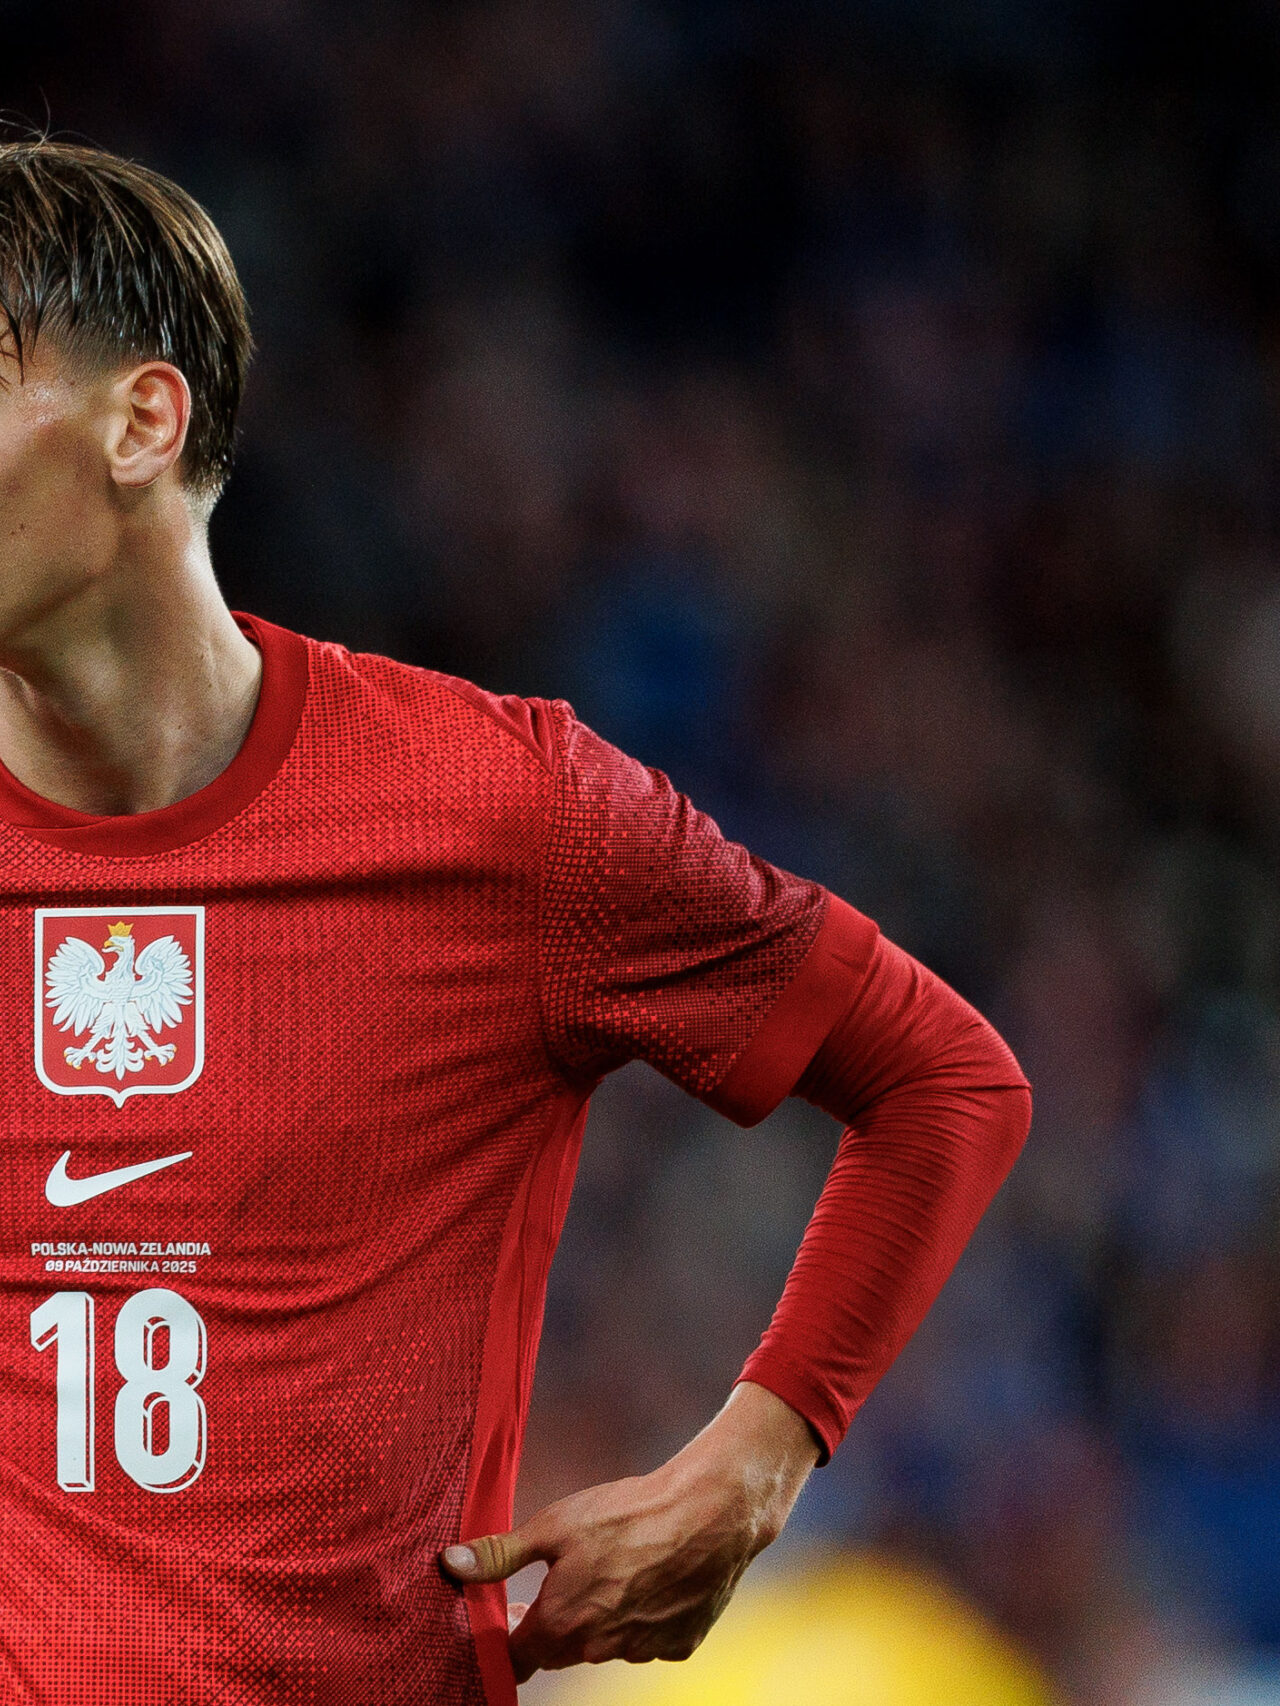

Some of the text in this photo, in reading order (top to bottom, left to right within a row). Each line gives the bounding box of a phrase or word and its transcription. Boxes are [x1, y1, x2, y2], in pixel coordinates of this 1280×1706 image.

[31, 1242, 211, 1256] POLSKA-NOWA ZELANDIA
[45, 1258, 197, 1273] 09 PAŹDZIERNIKA 2025
[30, 1288, 207, 1494] 18
